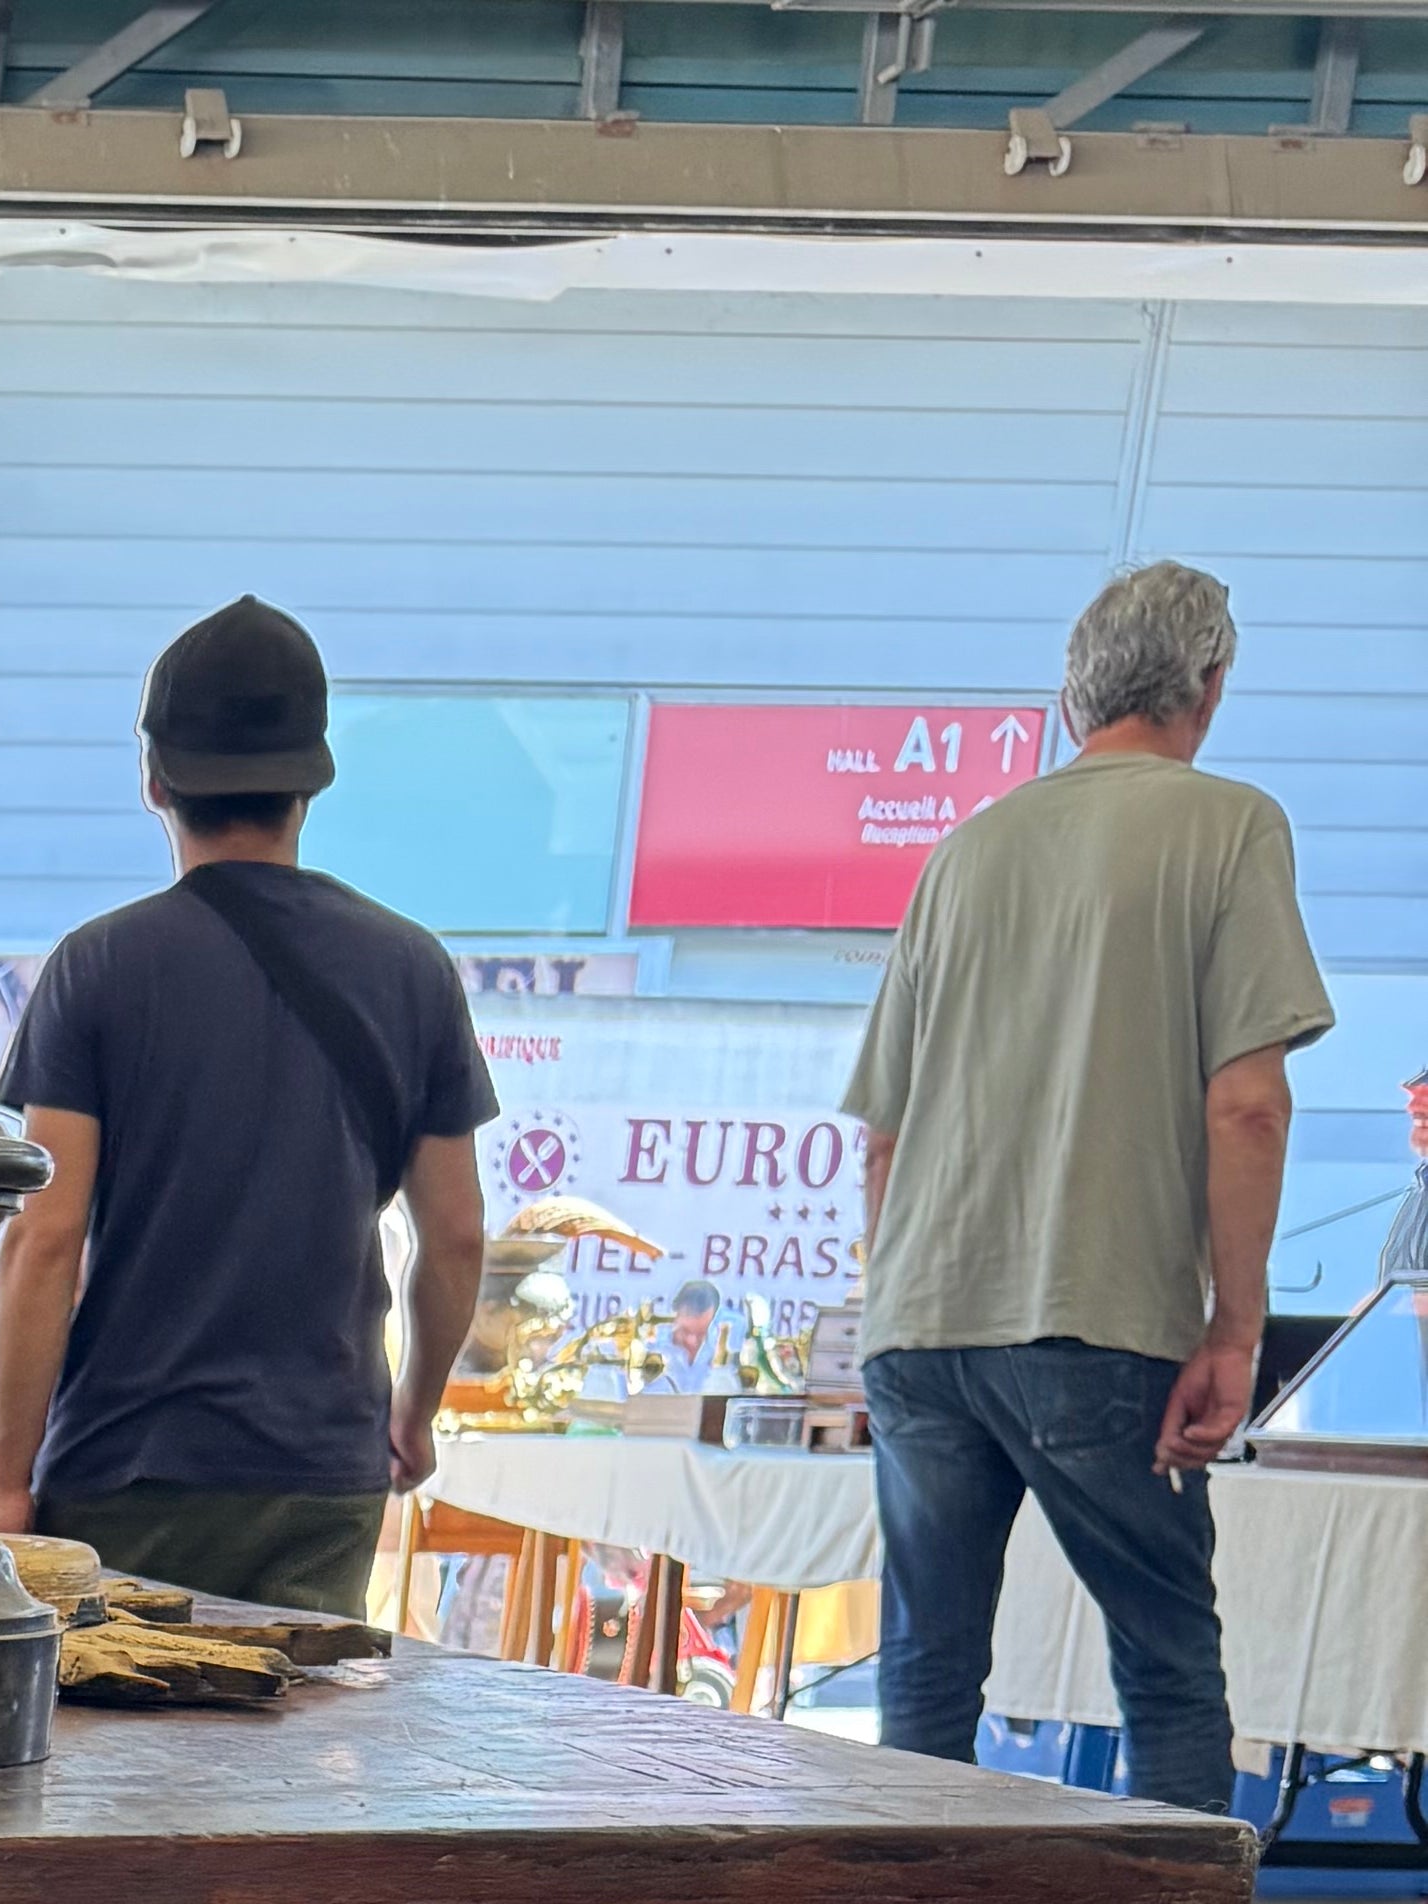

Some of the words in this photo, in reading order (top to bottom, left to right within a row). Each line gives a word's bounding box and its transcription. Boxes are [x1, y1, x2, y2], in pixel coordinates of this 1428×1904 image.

[826, 749, 881, 774] HALL
[893, 715, 963, 774] A1
[938, 795, 957, 821] A
[617, 1117, 869, 1190] EURO
